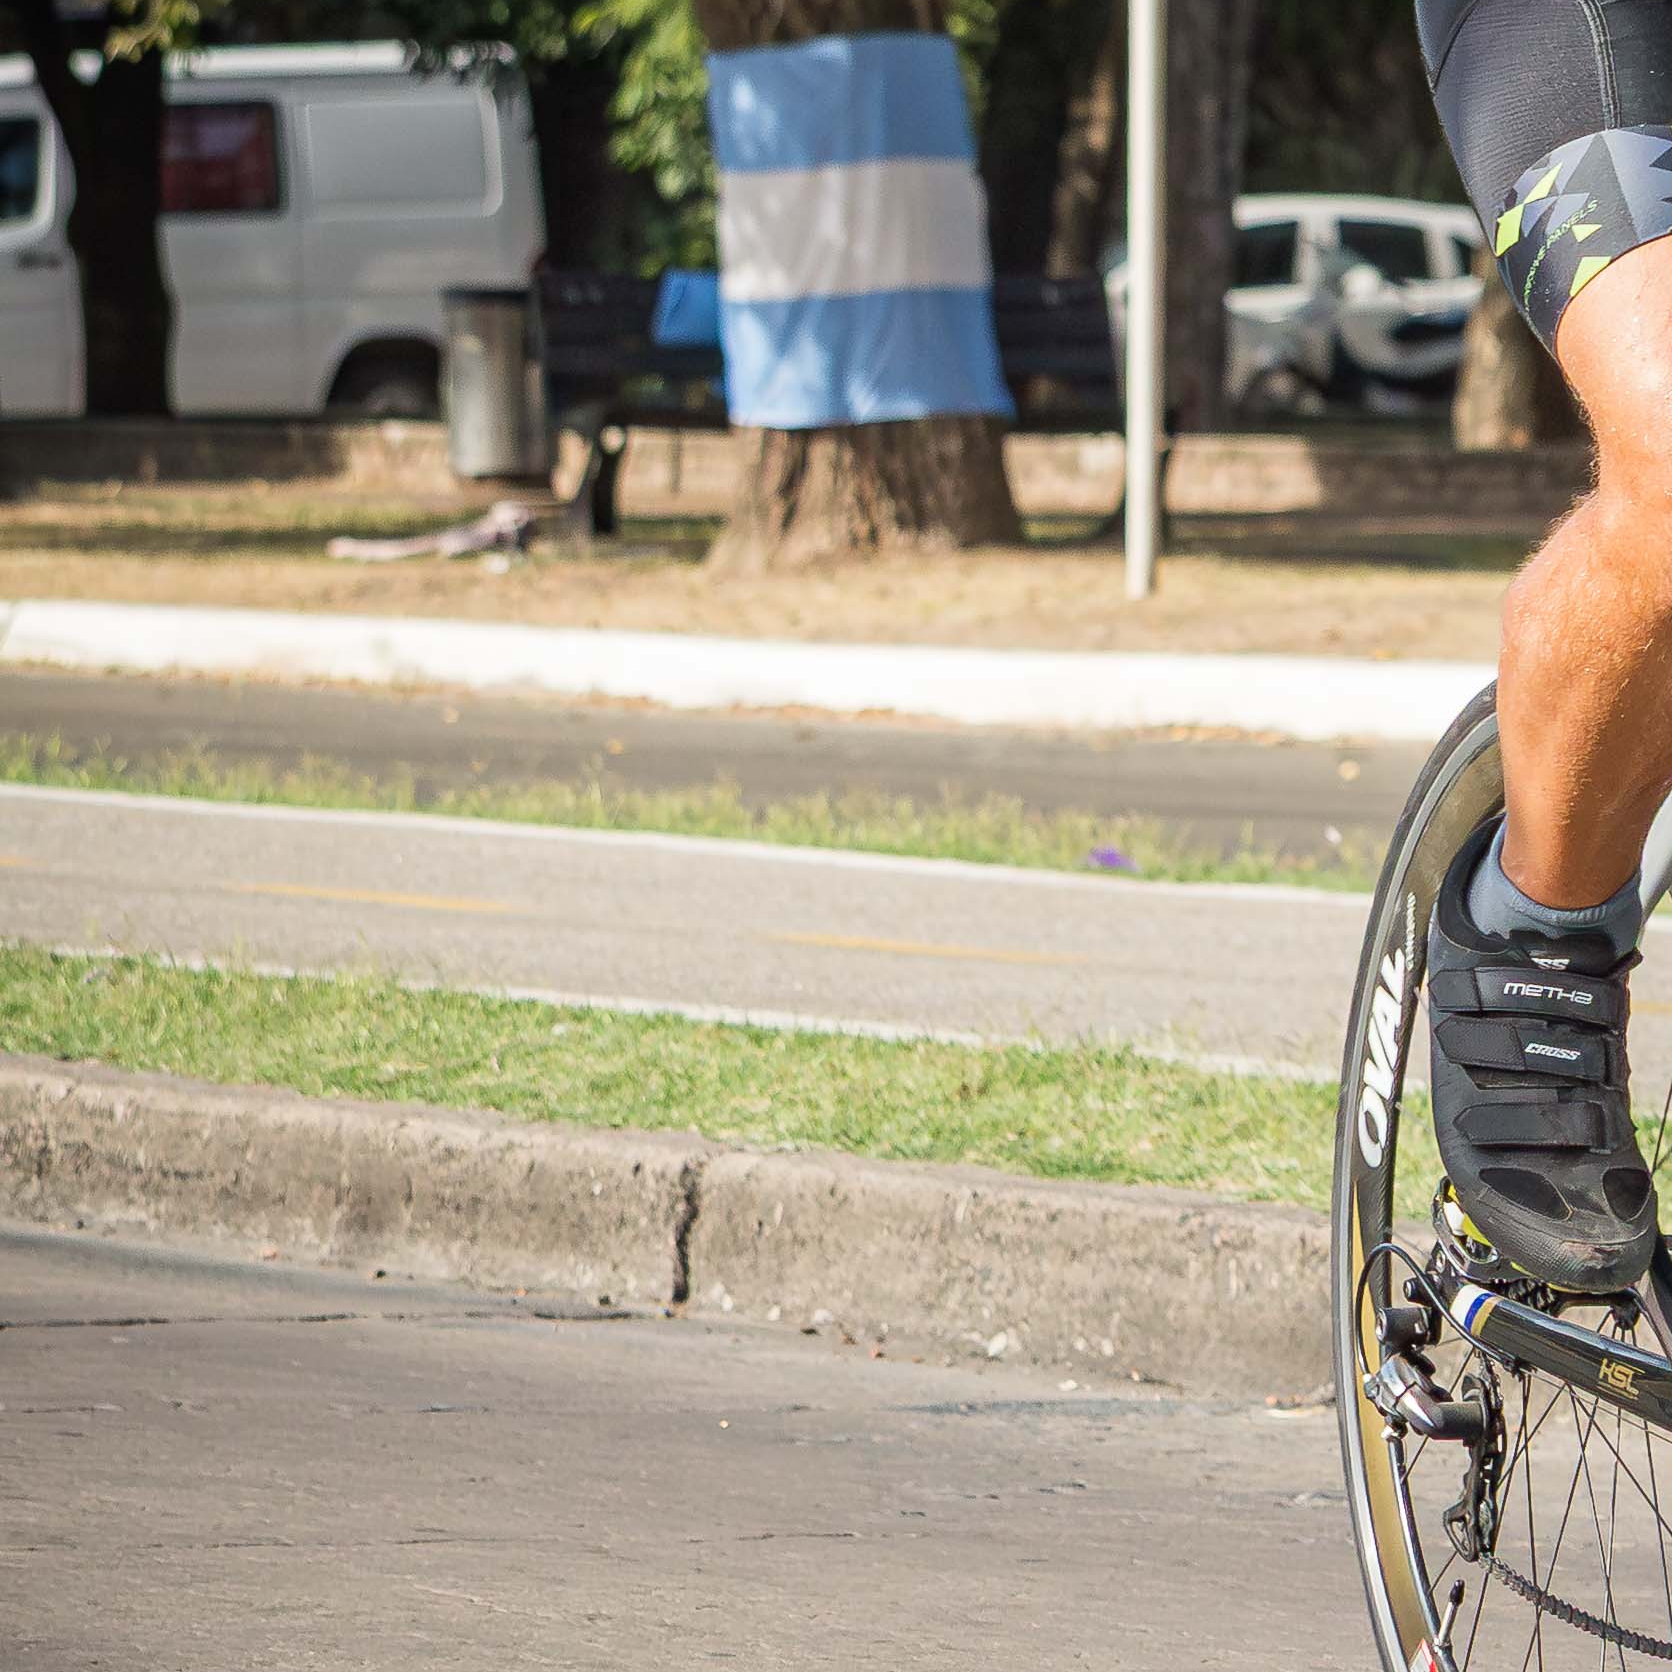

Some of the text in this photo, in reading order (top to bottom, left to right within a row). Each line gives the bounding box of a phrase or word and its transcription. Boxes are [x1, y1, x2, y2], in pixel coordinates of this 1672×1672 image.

[1358, 947, 1406, 1169] OVAL
[1524, 1042, 1581, 1061] CROSS
[1599, 1358, 1640, 1396] HSL
